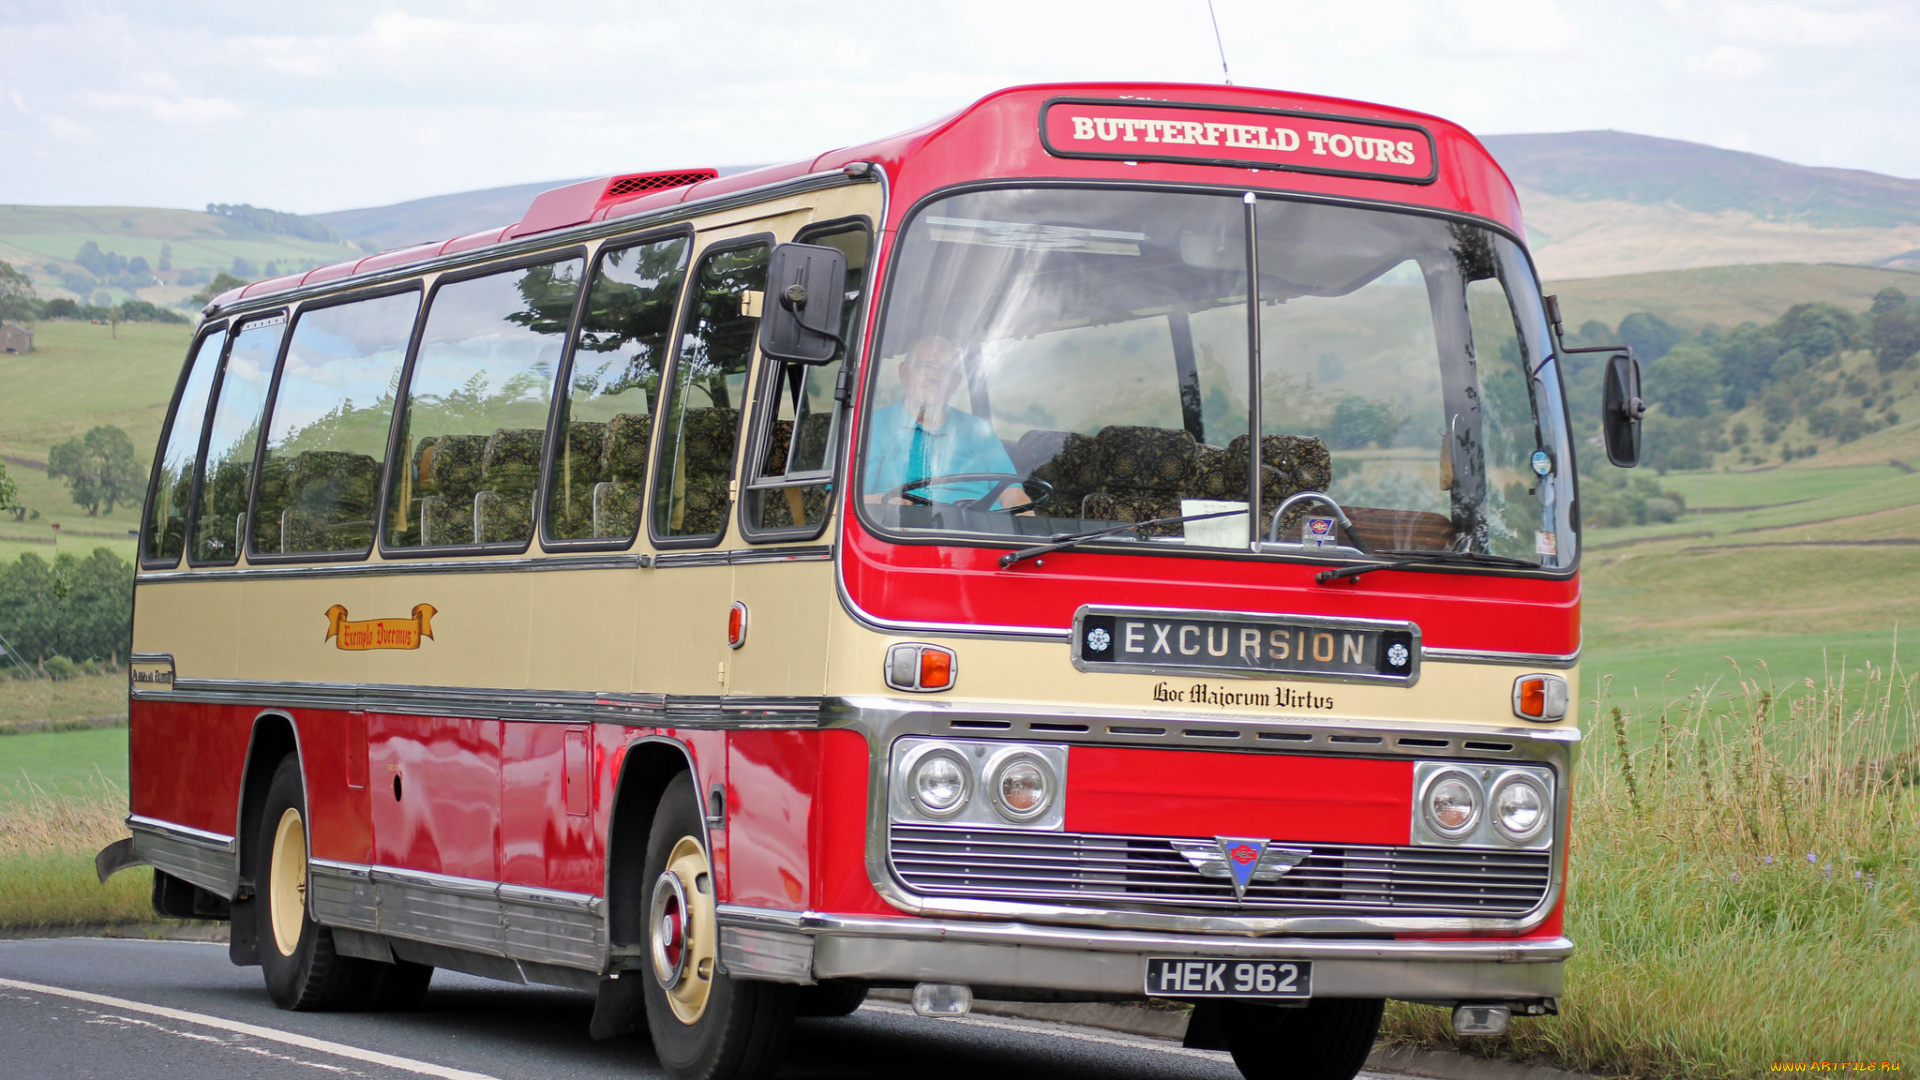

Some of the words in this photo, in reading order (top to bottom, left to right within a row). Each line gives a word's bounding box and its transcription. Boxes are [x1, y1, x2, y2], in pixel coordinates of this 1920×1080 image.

[1071, 116, 1300, 152] BUTTERFIELD
[1307, 130, 1416, 165] TOURS
[1124, 621, 1366, 665] EXCURSION
[1153, 681, 1185, 702] Hoc
[1189, 683, 1270, 709] Majorum
[1274, 686, 1334, 710] Virtus
[1233, 850, 1256, 859] AEC
[1160, 962, 1227, 991] HEK
[1234, 963, 1298, 992] 962
